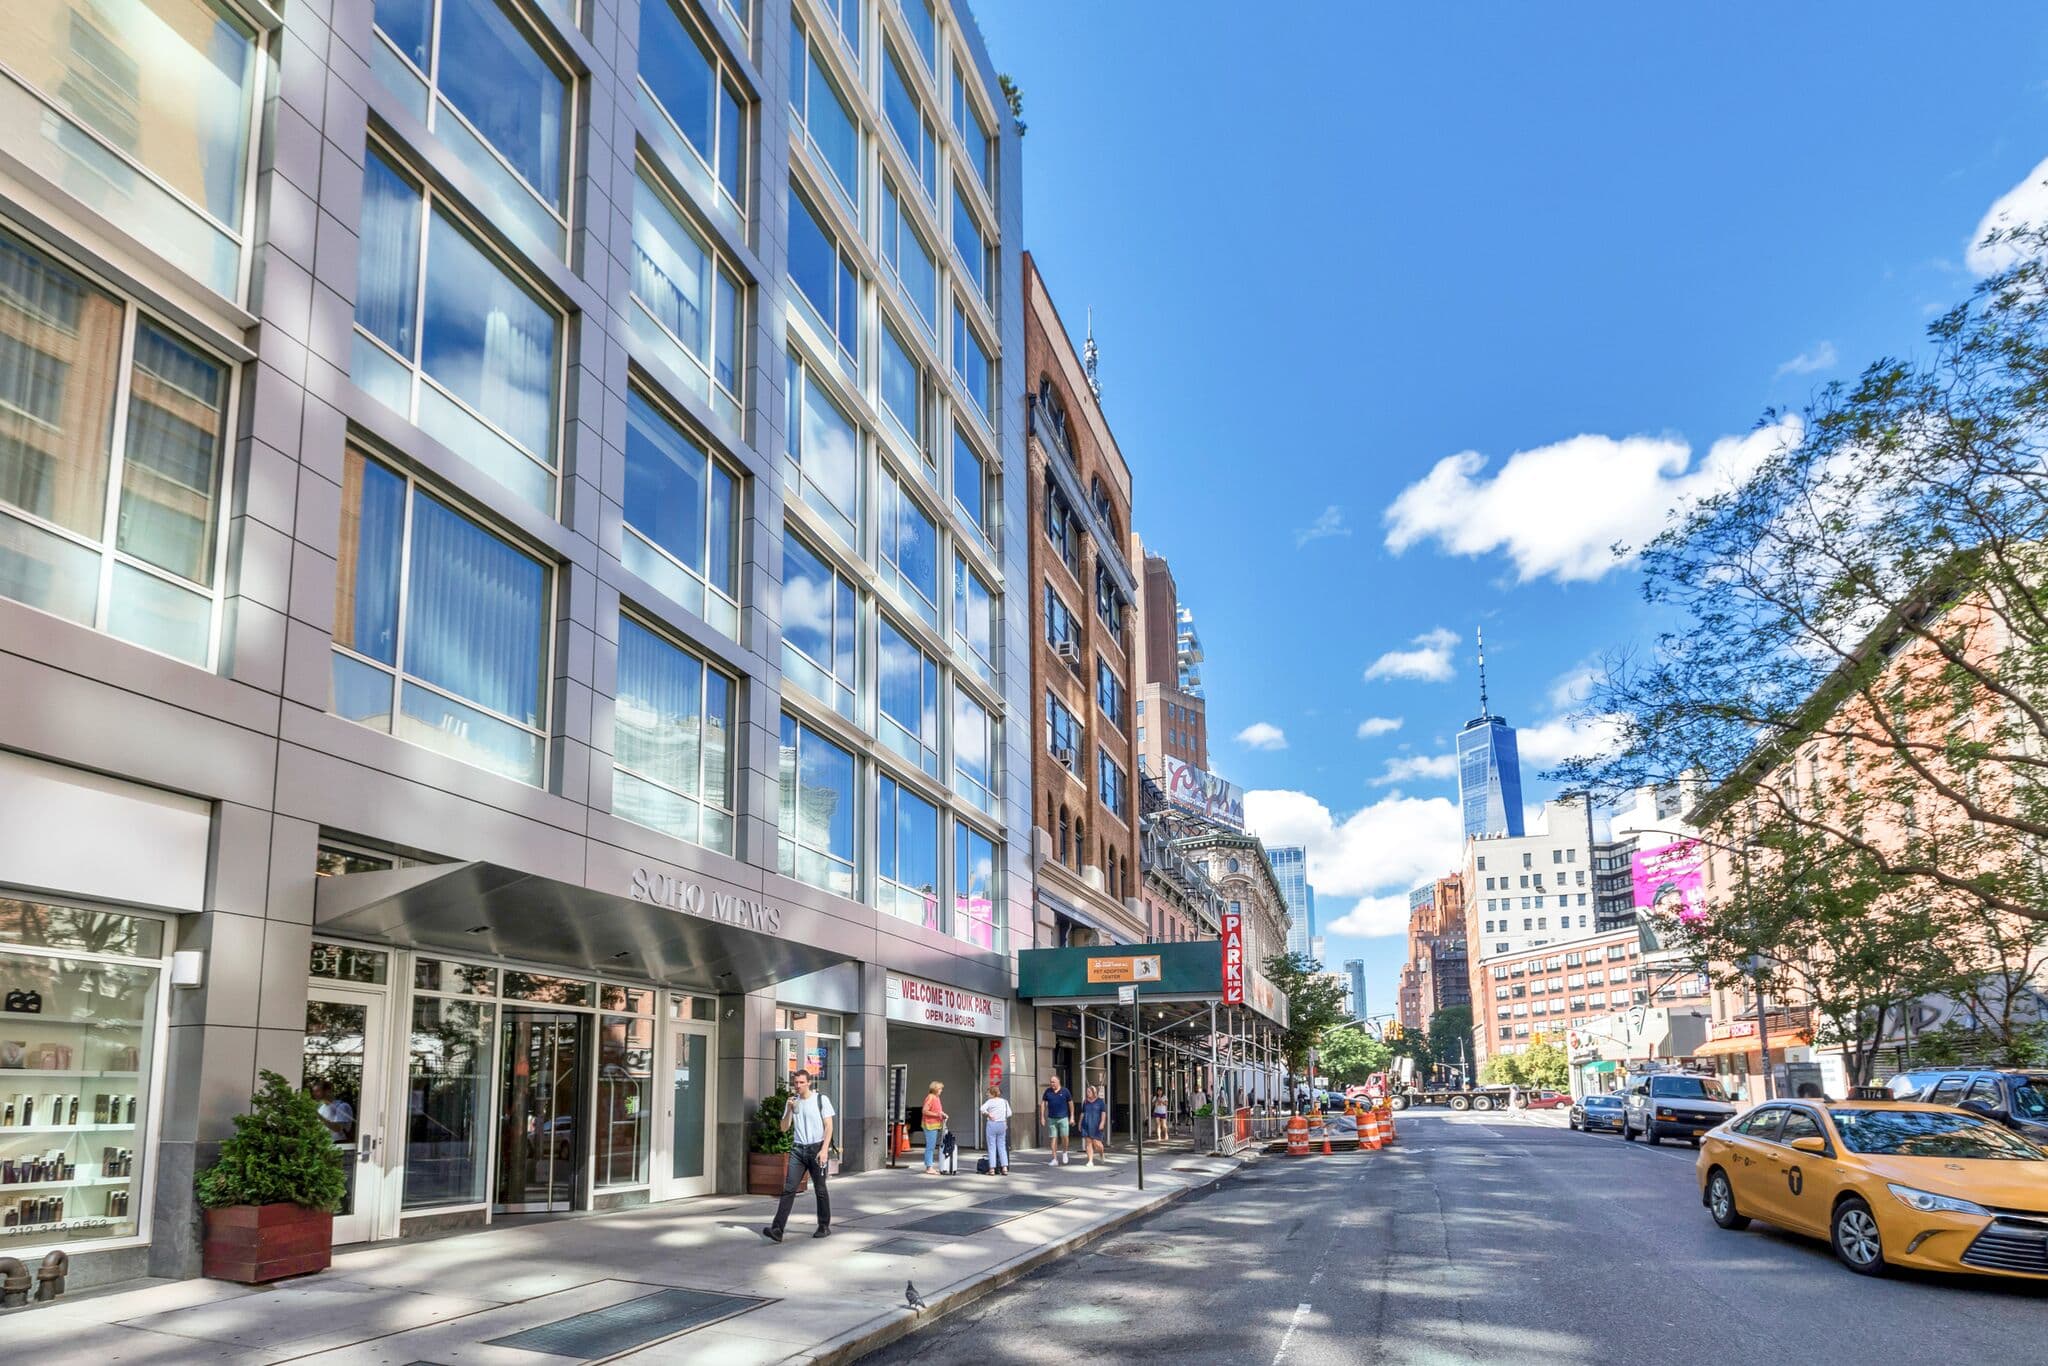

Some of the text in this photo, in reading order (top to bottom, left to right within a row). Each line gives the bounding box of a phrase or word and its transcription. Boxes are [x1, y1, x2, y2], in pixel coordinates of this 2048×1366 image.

[631, 868, 781, 934] SOHO MEWS
[312, 949, 357, 977] 311
[1226, 917, 1240, 979] PARK
[901, 979, 992, 1016] WELCOME TO QUIK PARK
[925, 1008, 975, 1028] OPEN 24 HOURS
